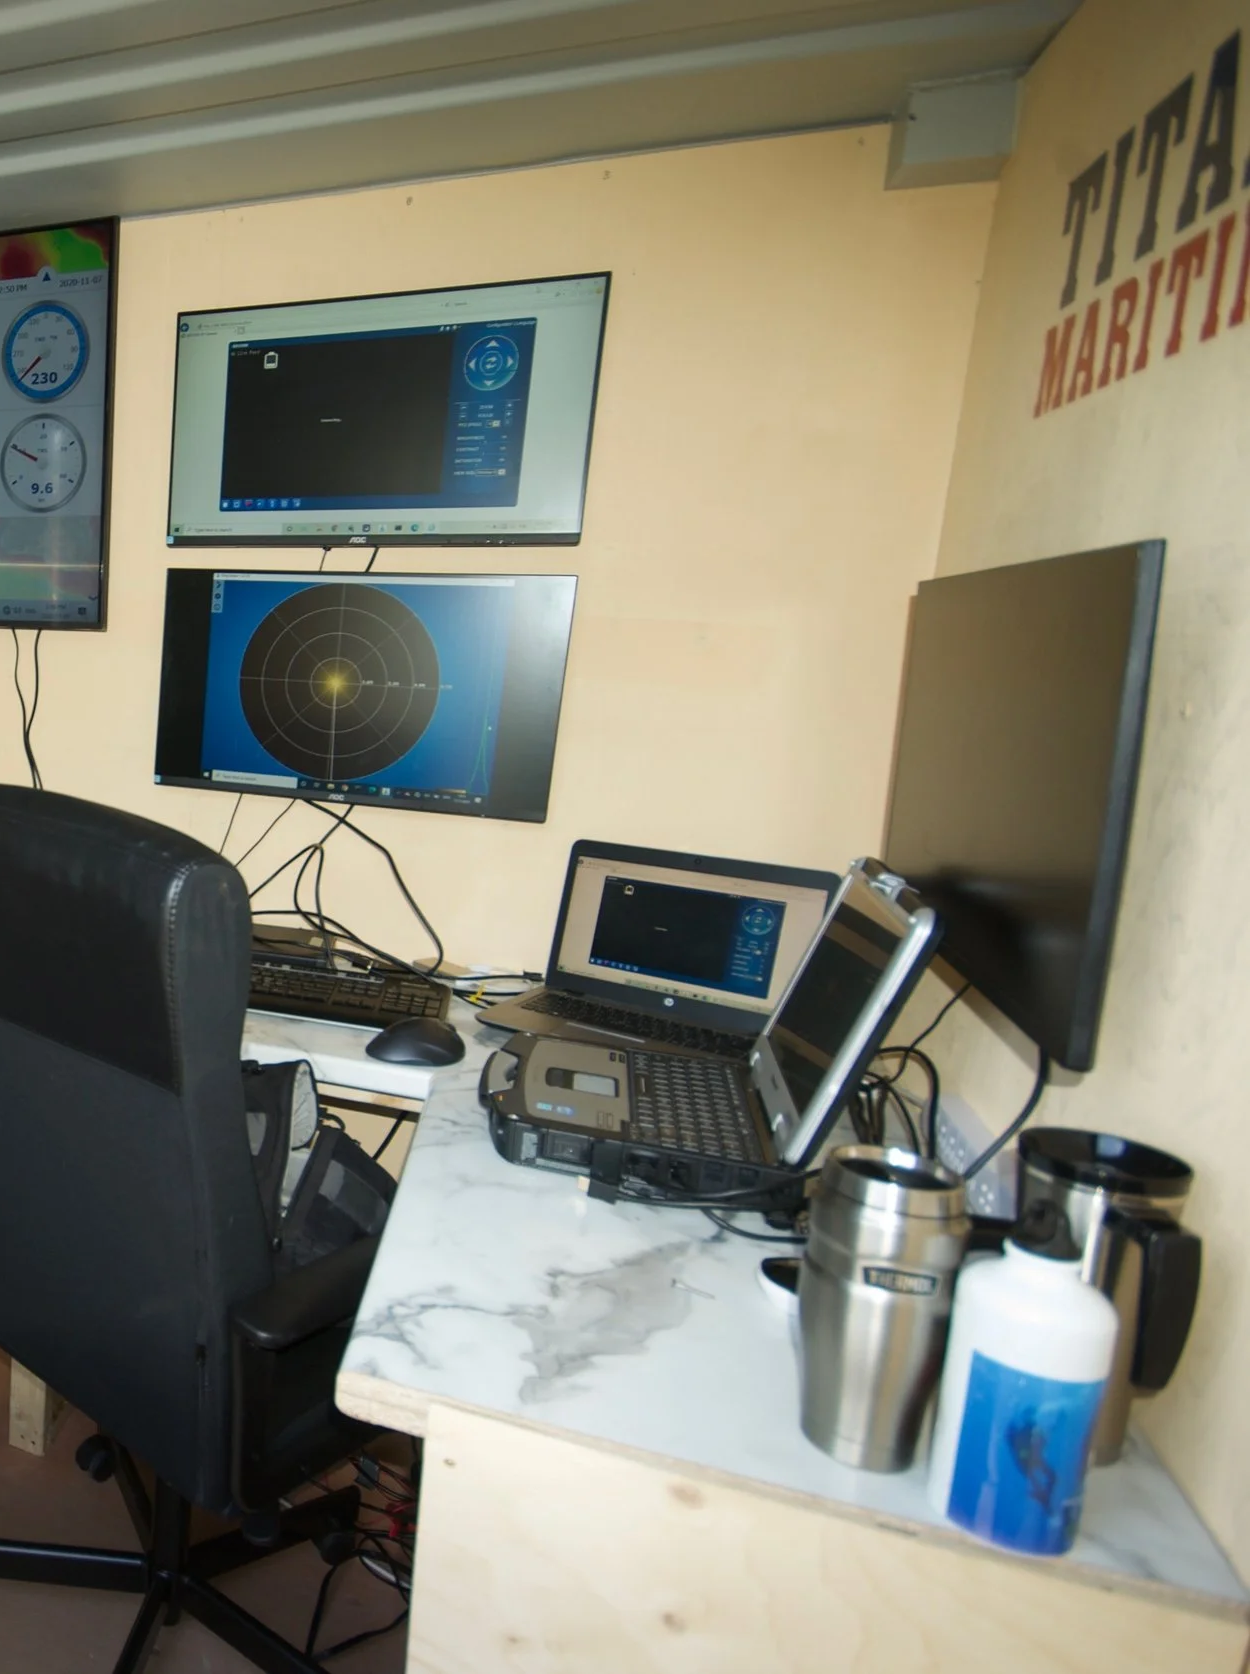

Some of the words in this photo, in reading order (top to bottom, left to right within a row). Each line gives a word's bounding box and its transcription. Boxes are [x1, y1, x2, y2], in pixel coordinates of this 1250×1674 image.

[1060, 28, 1250, 310] TITA
[31, 372, 58, 385] 230
[31, 482, 53, 495] 9.6
[349, 536, 367, 544] AOC
